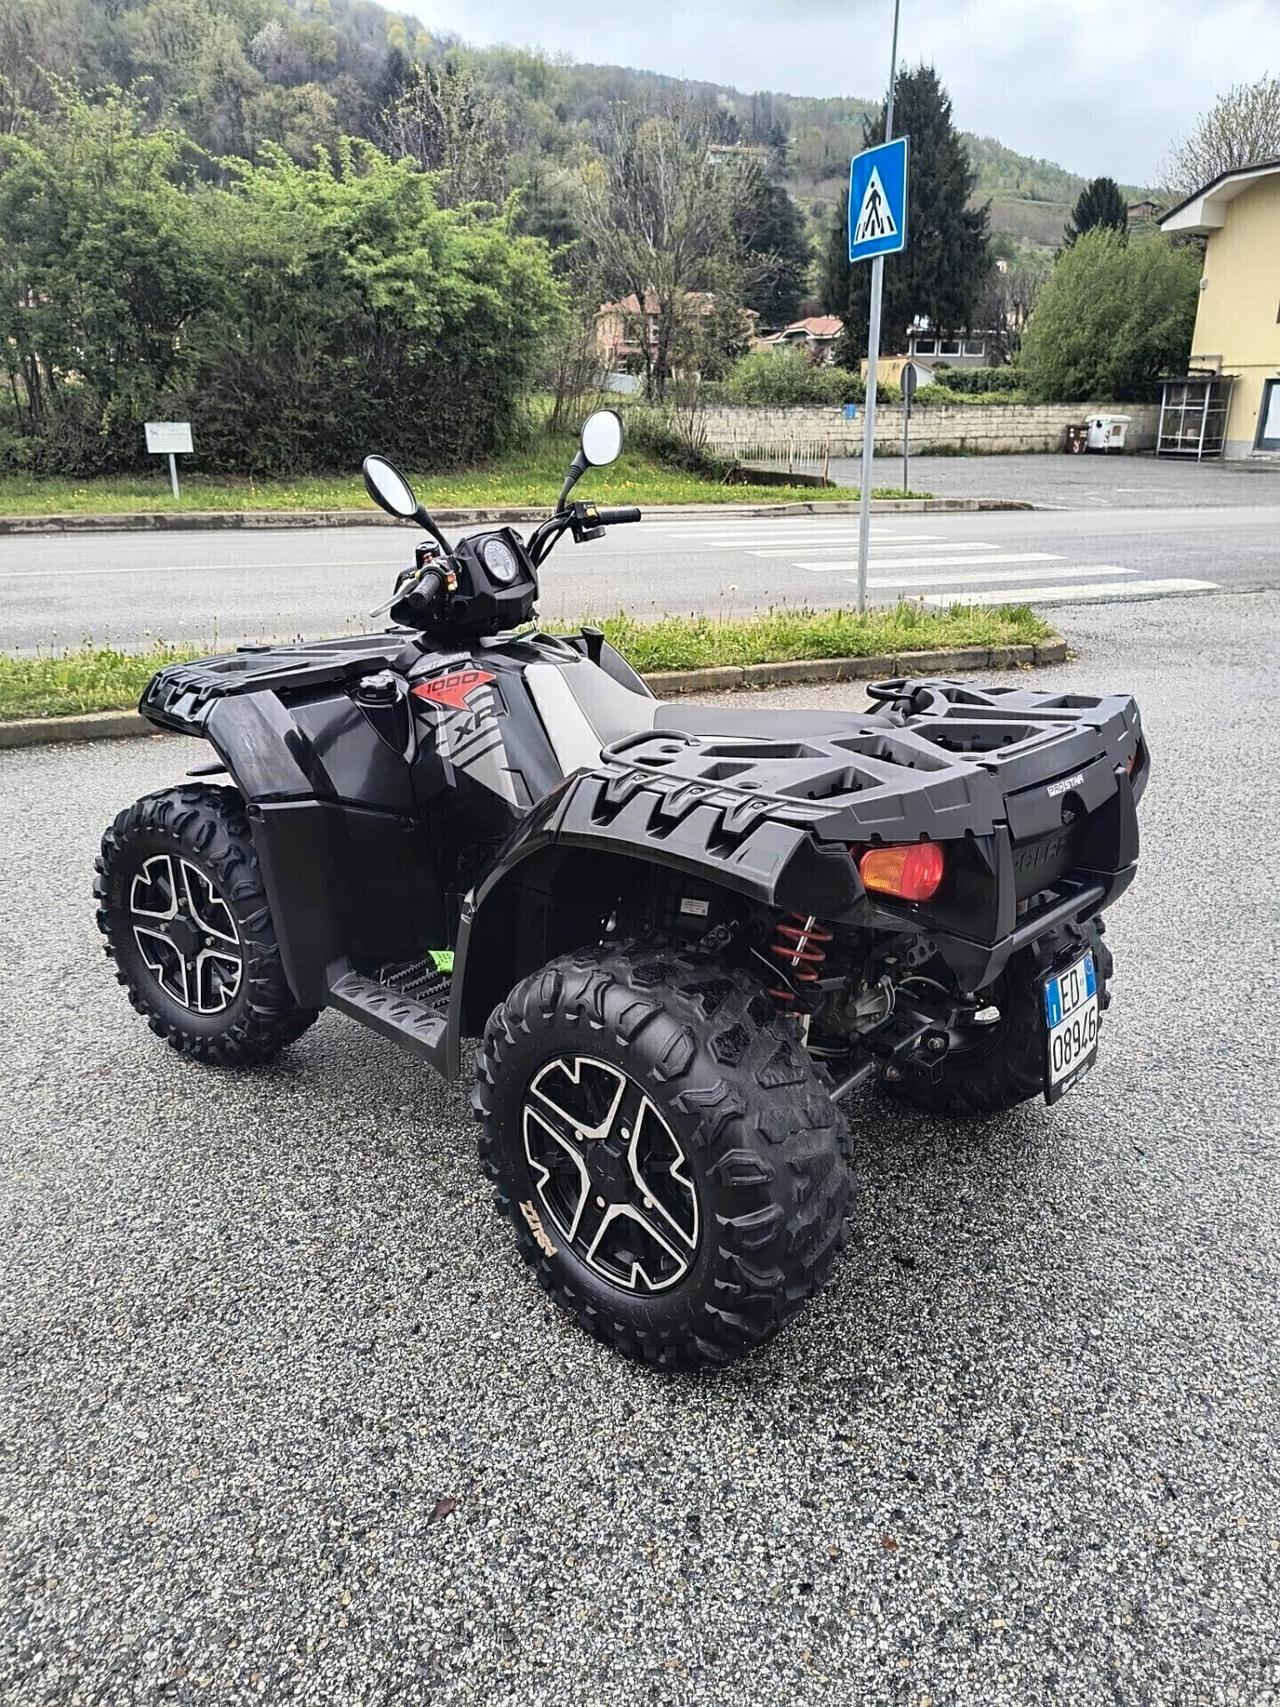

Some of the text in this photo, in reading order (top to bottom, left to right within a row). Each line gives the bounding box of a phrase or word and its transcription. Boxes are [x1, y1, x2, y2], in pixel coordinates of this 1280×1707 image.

[426, 672, 479, 693] 1000
[1047, 774, 1085, 798] PROSTAR
[1060, 969, 1080, 1015] ED
[1053, 1006, 1096, 1073] 08946
